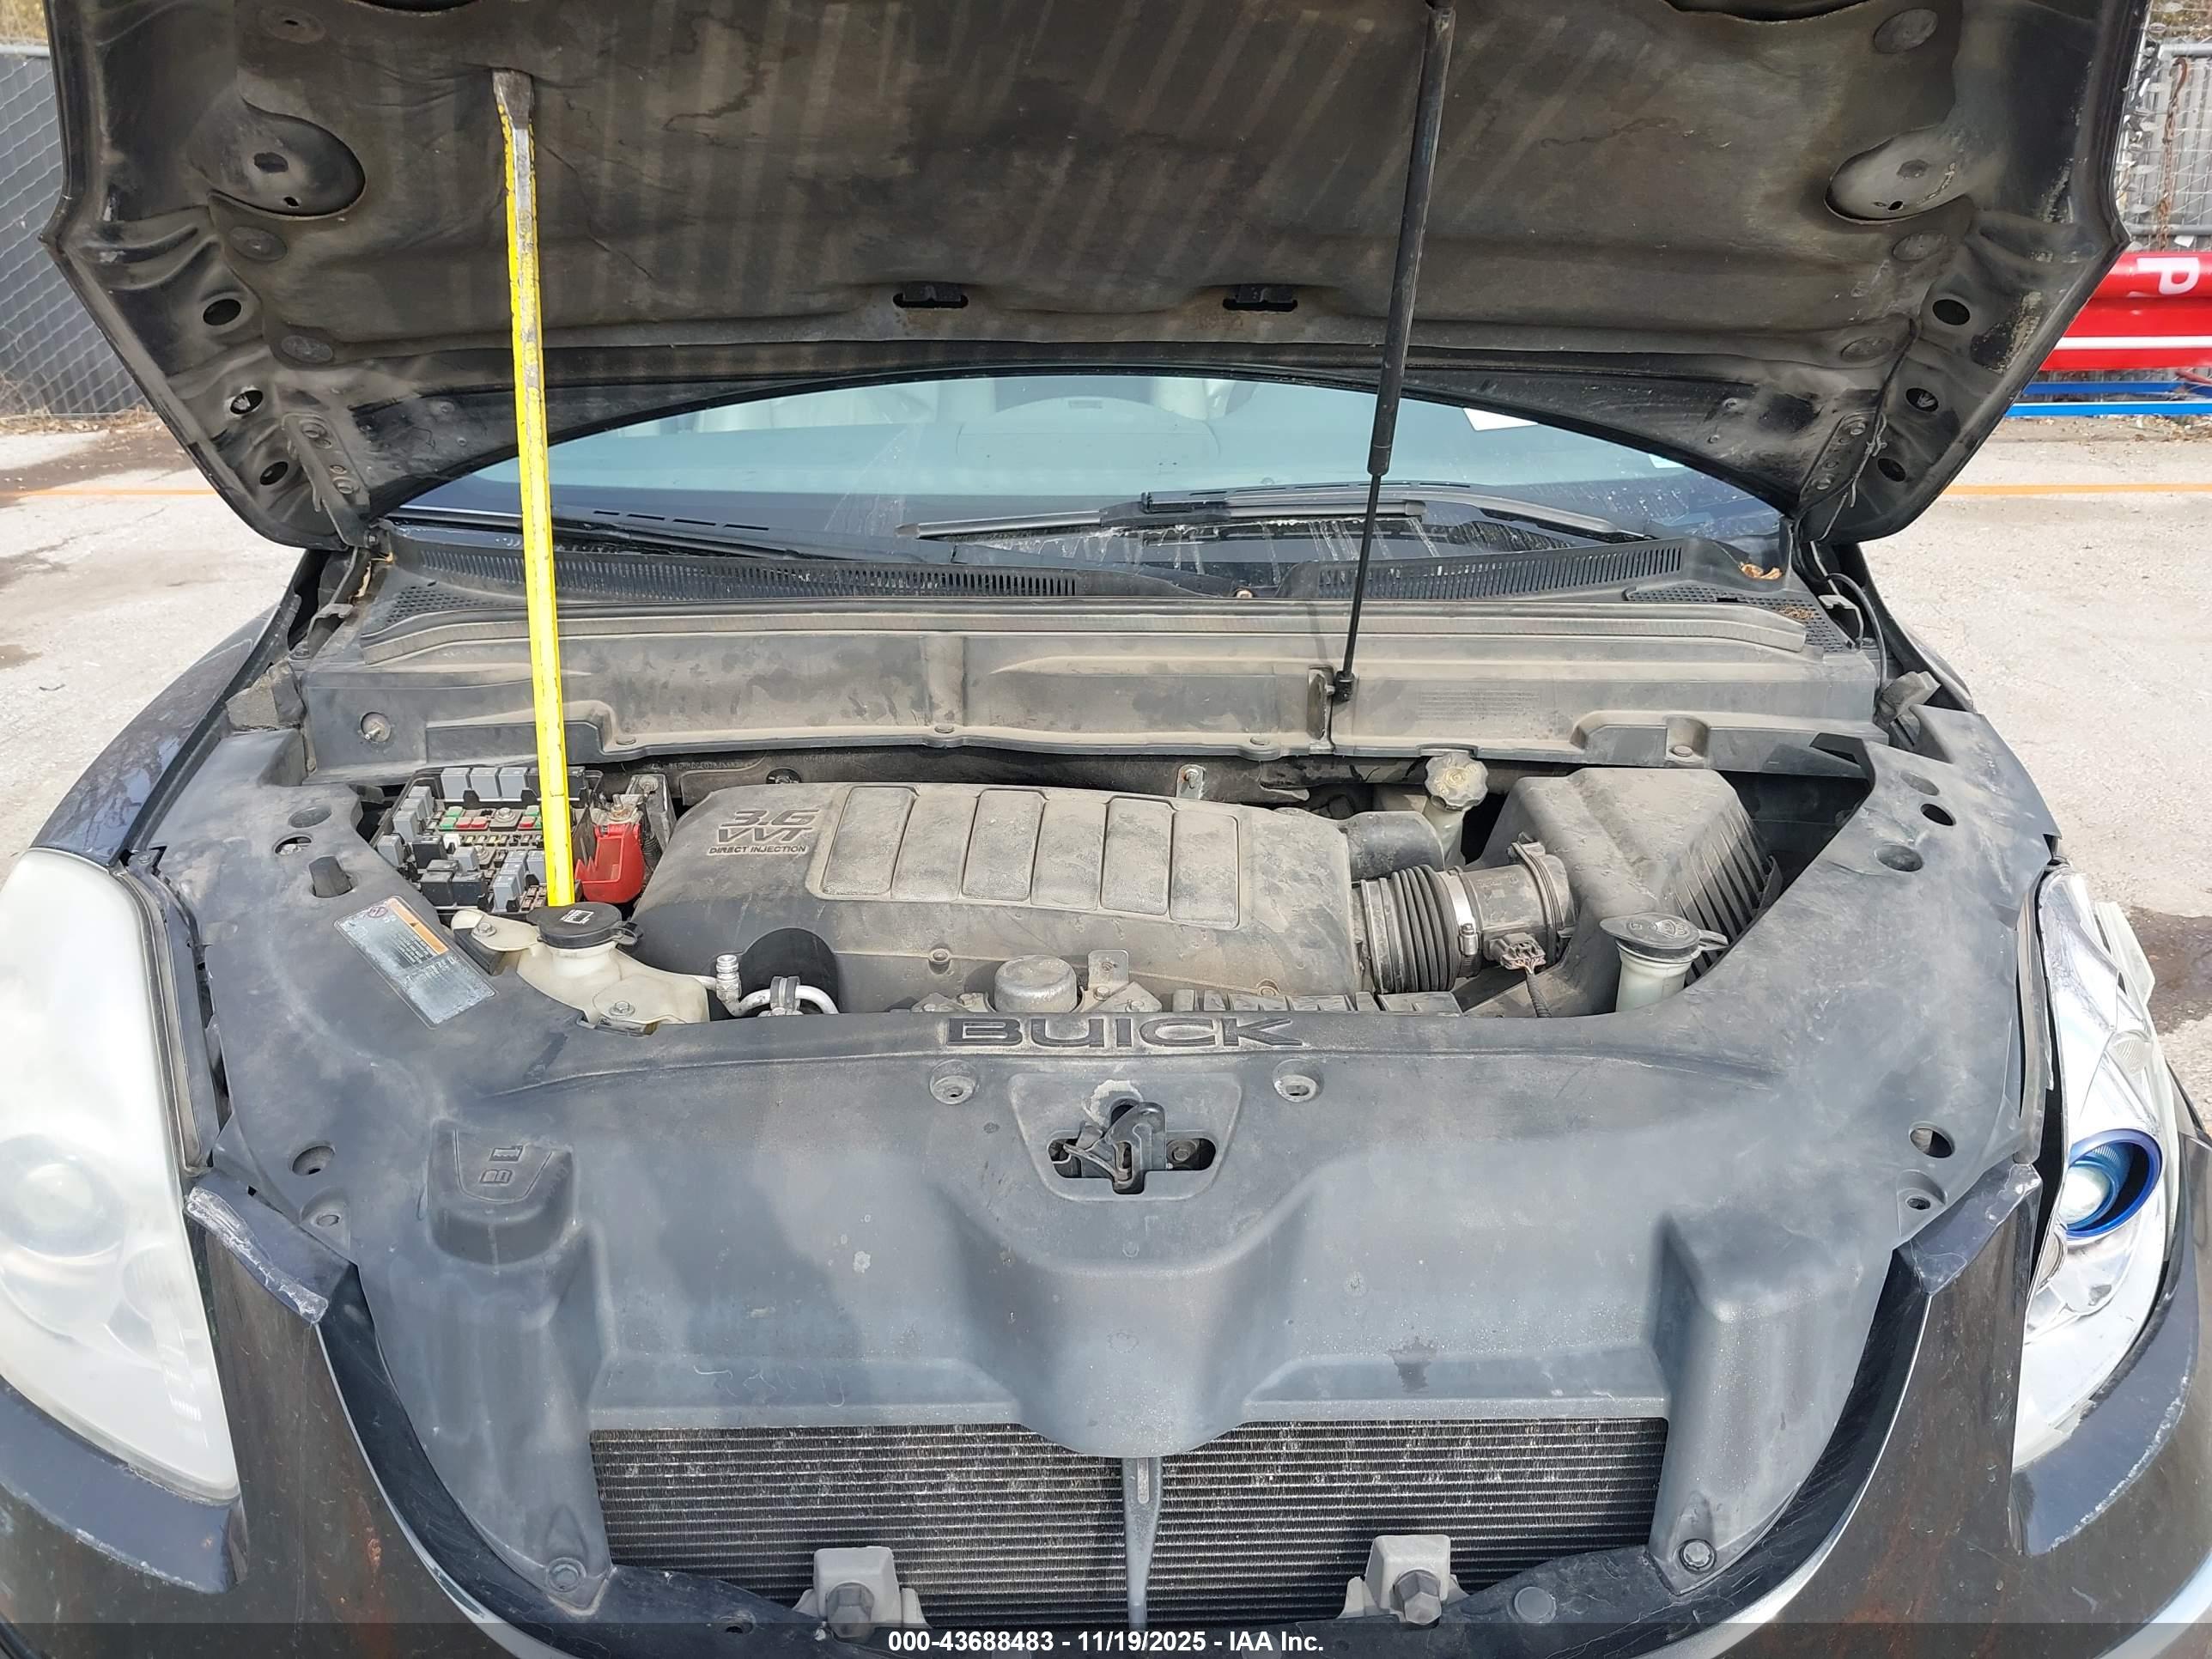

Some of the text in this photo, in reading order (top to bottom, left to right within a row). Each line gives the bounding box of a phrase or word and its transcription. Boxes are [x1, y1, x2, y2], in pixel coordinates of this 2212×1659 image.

[720, 809, 820, 827] 3.6
[718, 827, 813, 842] VVT
[708, 845, 806, 854] DIRECT INJECTION
[946, 1018, 1304, 1048] BUICK
